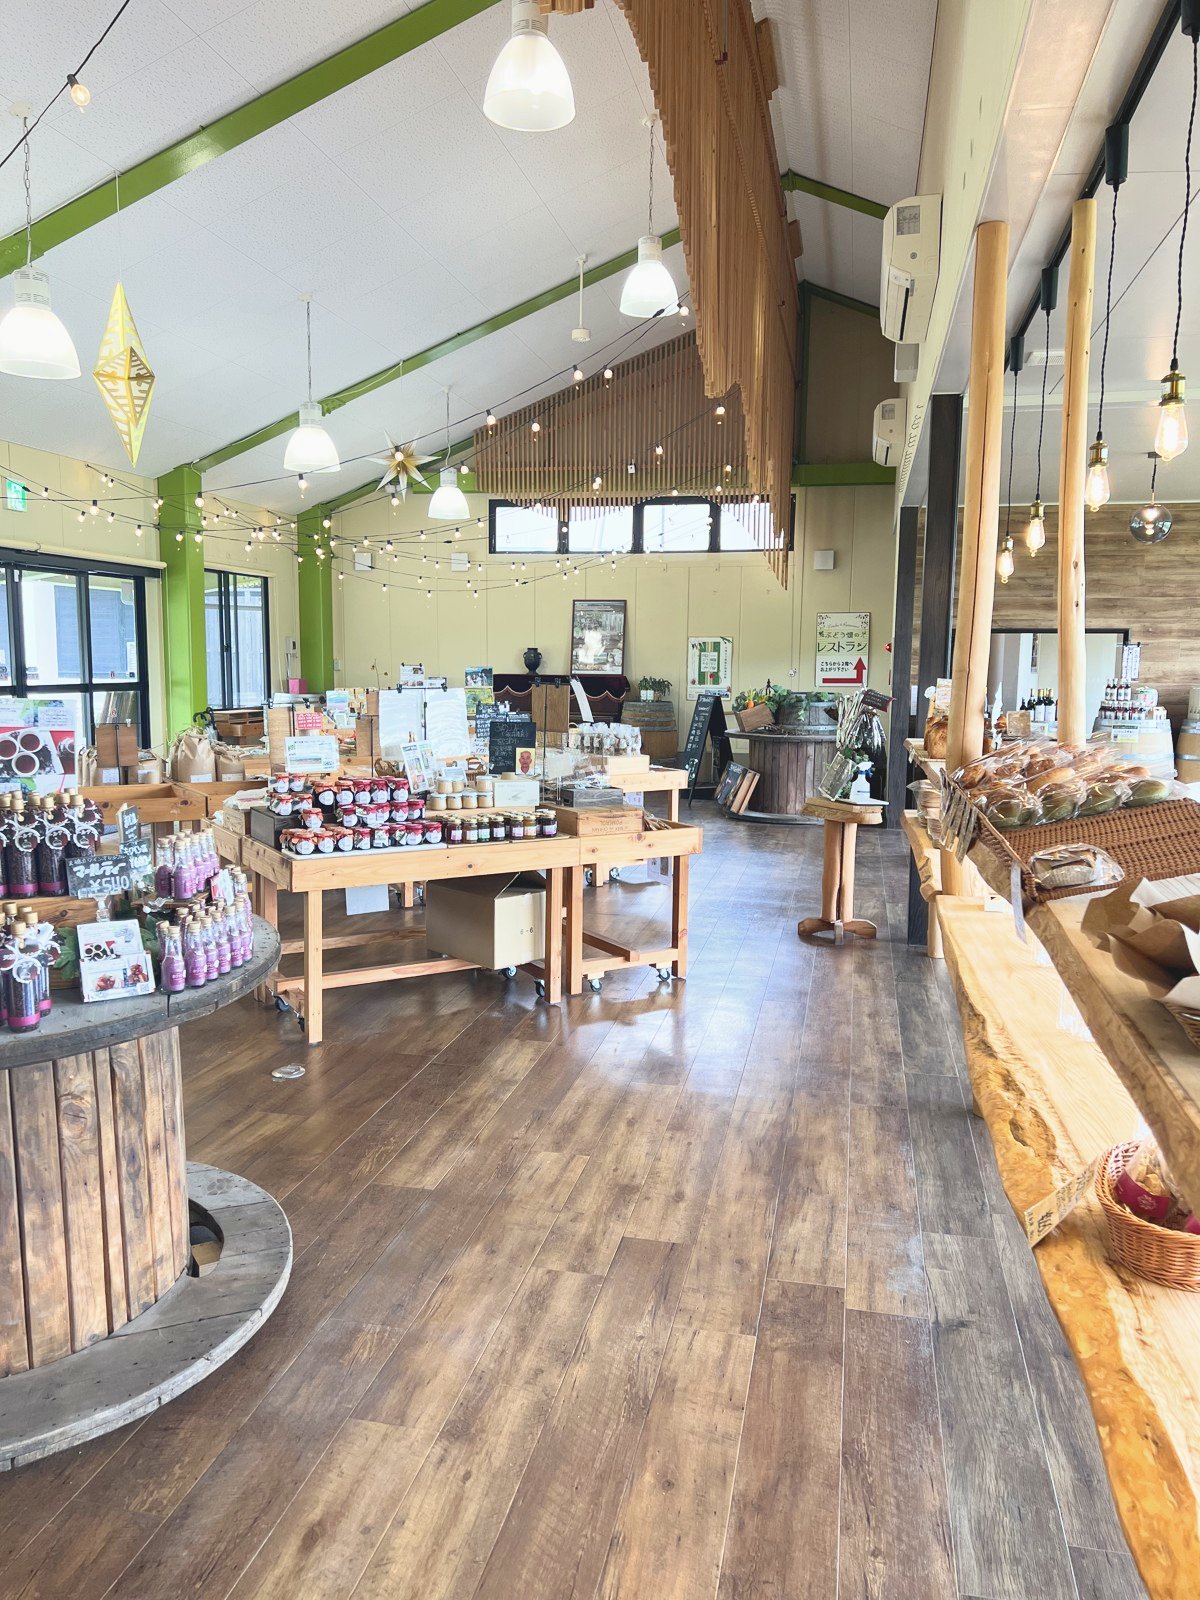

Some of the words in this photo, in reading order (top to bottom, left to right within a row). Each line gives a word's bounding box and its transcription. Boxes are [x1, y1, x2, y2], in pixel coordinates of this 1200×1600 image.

[817, 641, 867, 653] レストラン
[88, 875, 130, 893] ¥540
